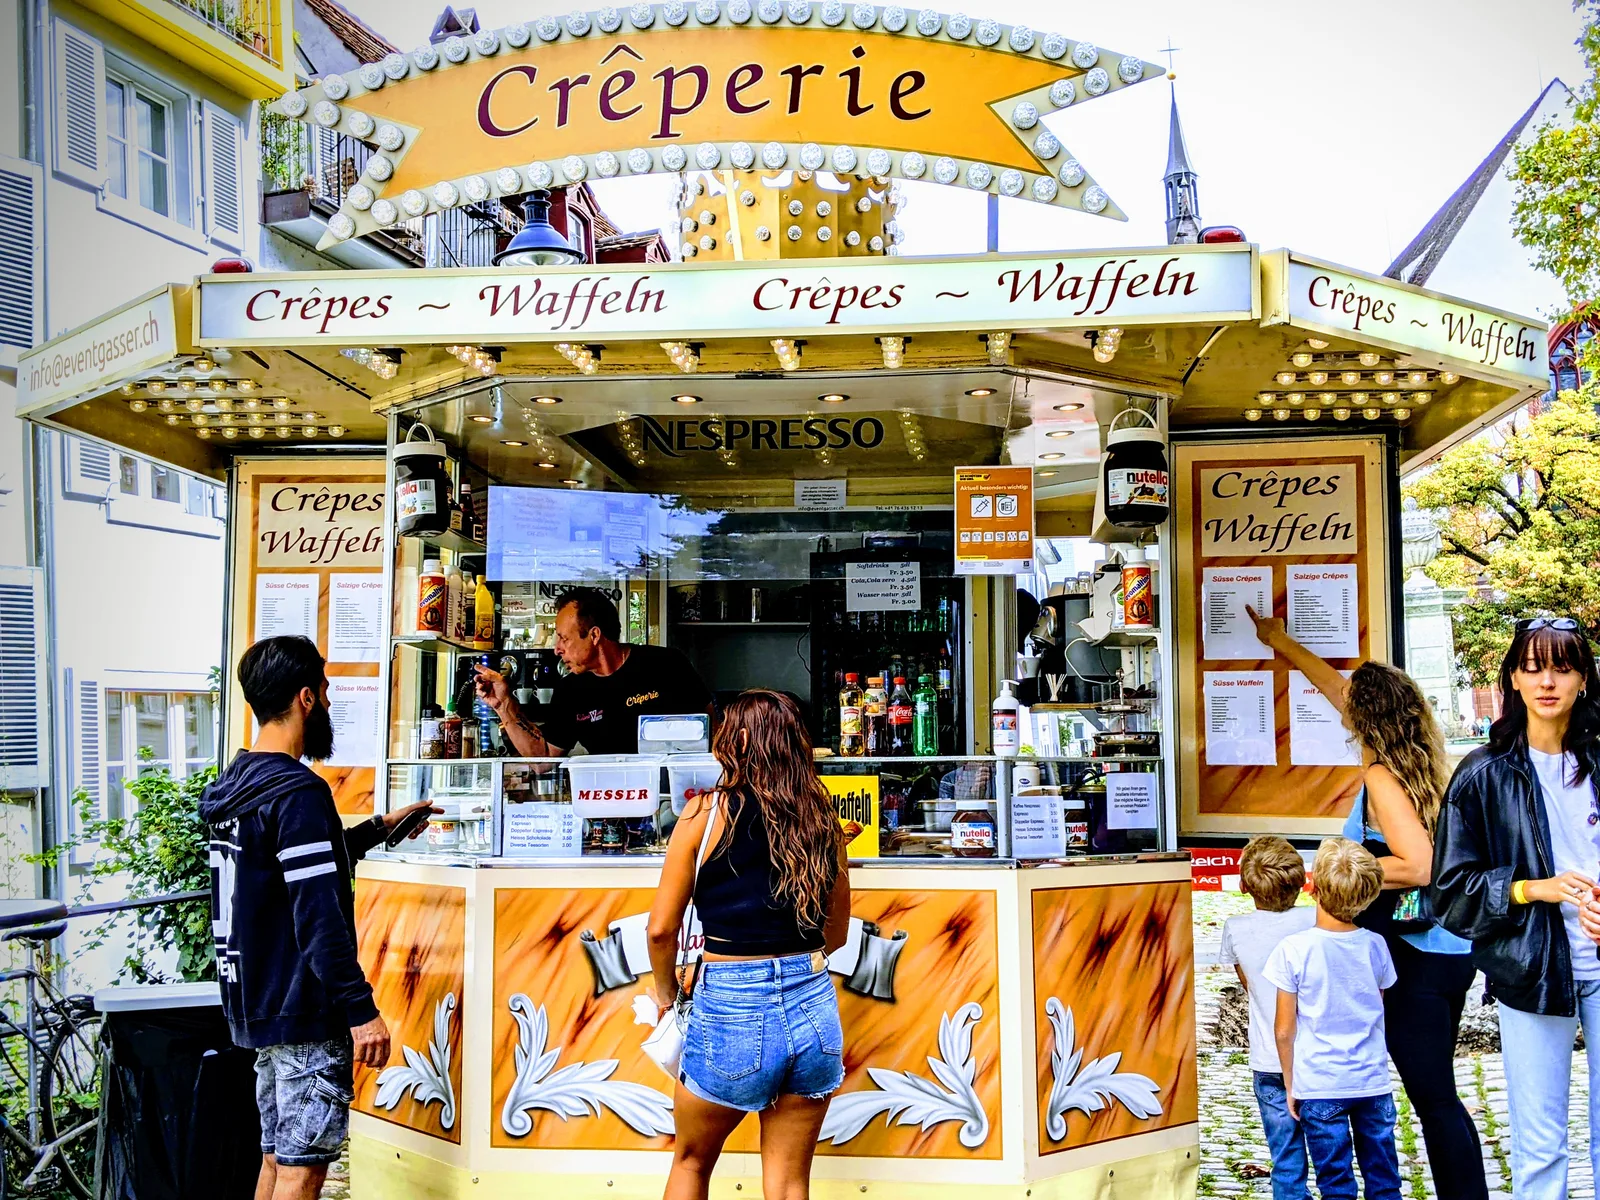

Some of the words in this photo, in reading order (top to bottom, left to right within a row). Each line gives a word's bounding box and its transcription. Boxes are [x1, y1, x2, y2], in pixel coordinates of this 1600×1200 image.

[477, 43, 932, 139] Crêperie
[246, 287, 393, 334] Crêpes
[479, 276, 668, 330] Waffeln
[752, 277, 905, 324] Crêpes
[998, 257, 1199, 316] Waffeln
[1308, 276, 1396, 331] Crêpes
[1442, 312, 1537, 365] Waffeln
[30, 310, 159, 392] info@eventgasser.ch
[631, 413, 884, 458] NESPRESSO
[1126, 469, 1168, 485] nutella
[1212, 470, 1341, 508] Crêpes
[271, 486, 385, 522] Crêpes
[1205, 513, 1354, 552] Waffeln
[336, 582, 360, 590] Salzige
[335, 684, 354, 692] Süsse
[626, 690, 659, 707] Crêperie
[578, 789, 649, 800] MESSER
[960, 829, 990, 838] nutella
[1199, 876, 1219, 884] AG
